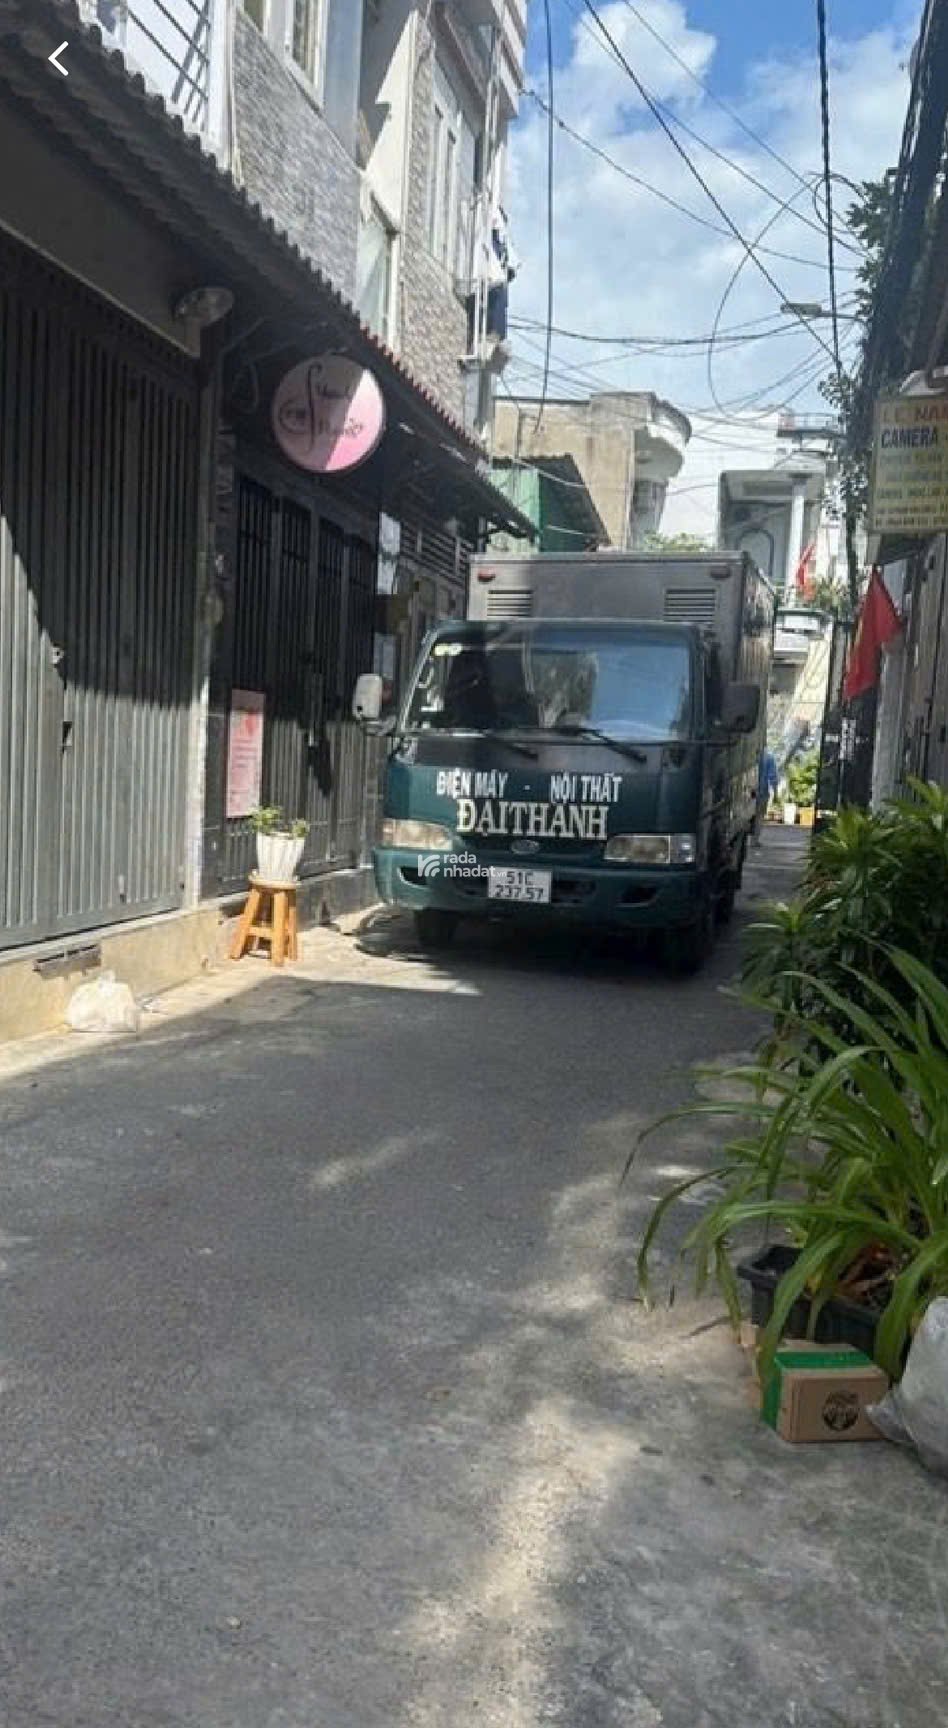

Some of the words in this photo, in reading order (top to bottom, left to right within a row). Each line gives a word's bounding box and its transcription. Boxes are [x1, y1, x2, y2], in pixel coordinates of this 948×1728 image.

[881, 426, 938, 448] CAMERA
[474, 769, 508, 798] MÁY
[550, 772, 577, 804] NỘI
[507, 871, 533, 885] 51C
